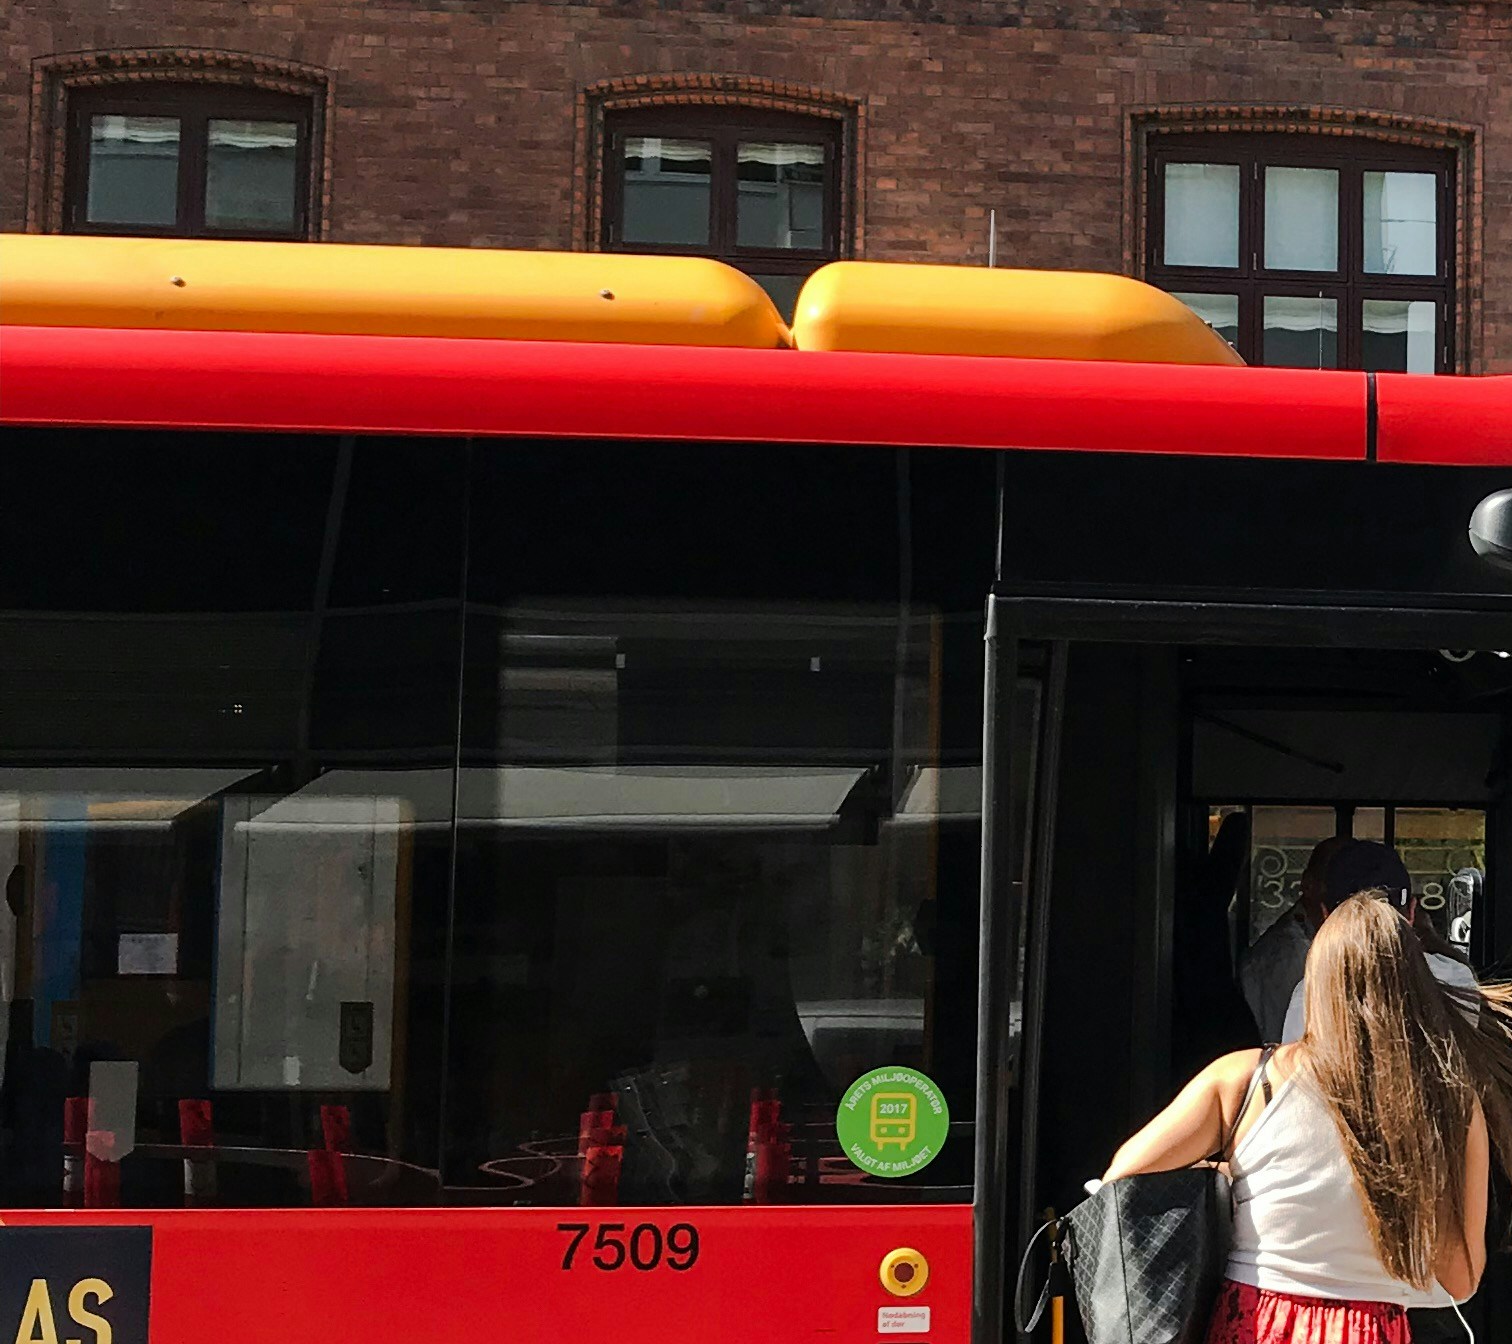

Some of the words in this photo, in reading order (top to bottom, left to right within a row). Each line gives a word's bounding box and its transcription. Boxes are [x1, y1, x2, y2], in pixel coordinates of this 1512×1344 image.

[844, 1081, 872, 1111] ÅRETS
[880, 1103, 908, 1114] 2017
[850, 1143, 878, 1168] VALGT
[877, 1161, 890, 1171] AF
[557, 1222, 699, 1271] 7509
